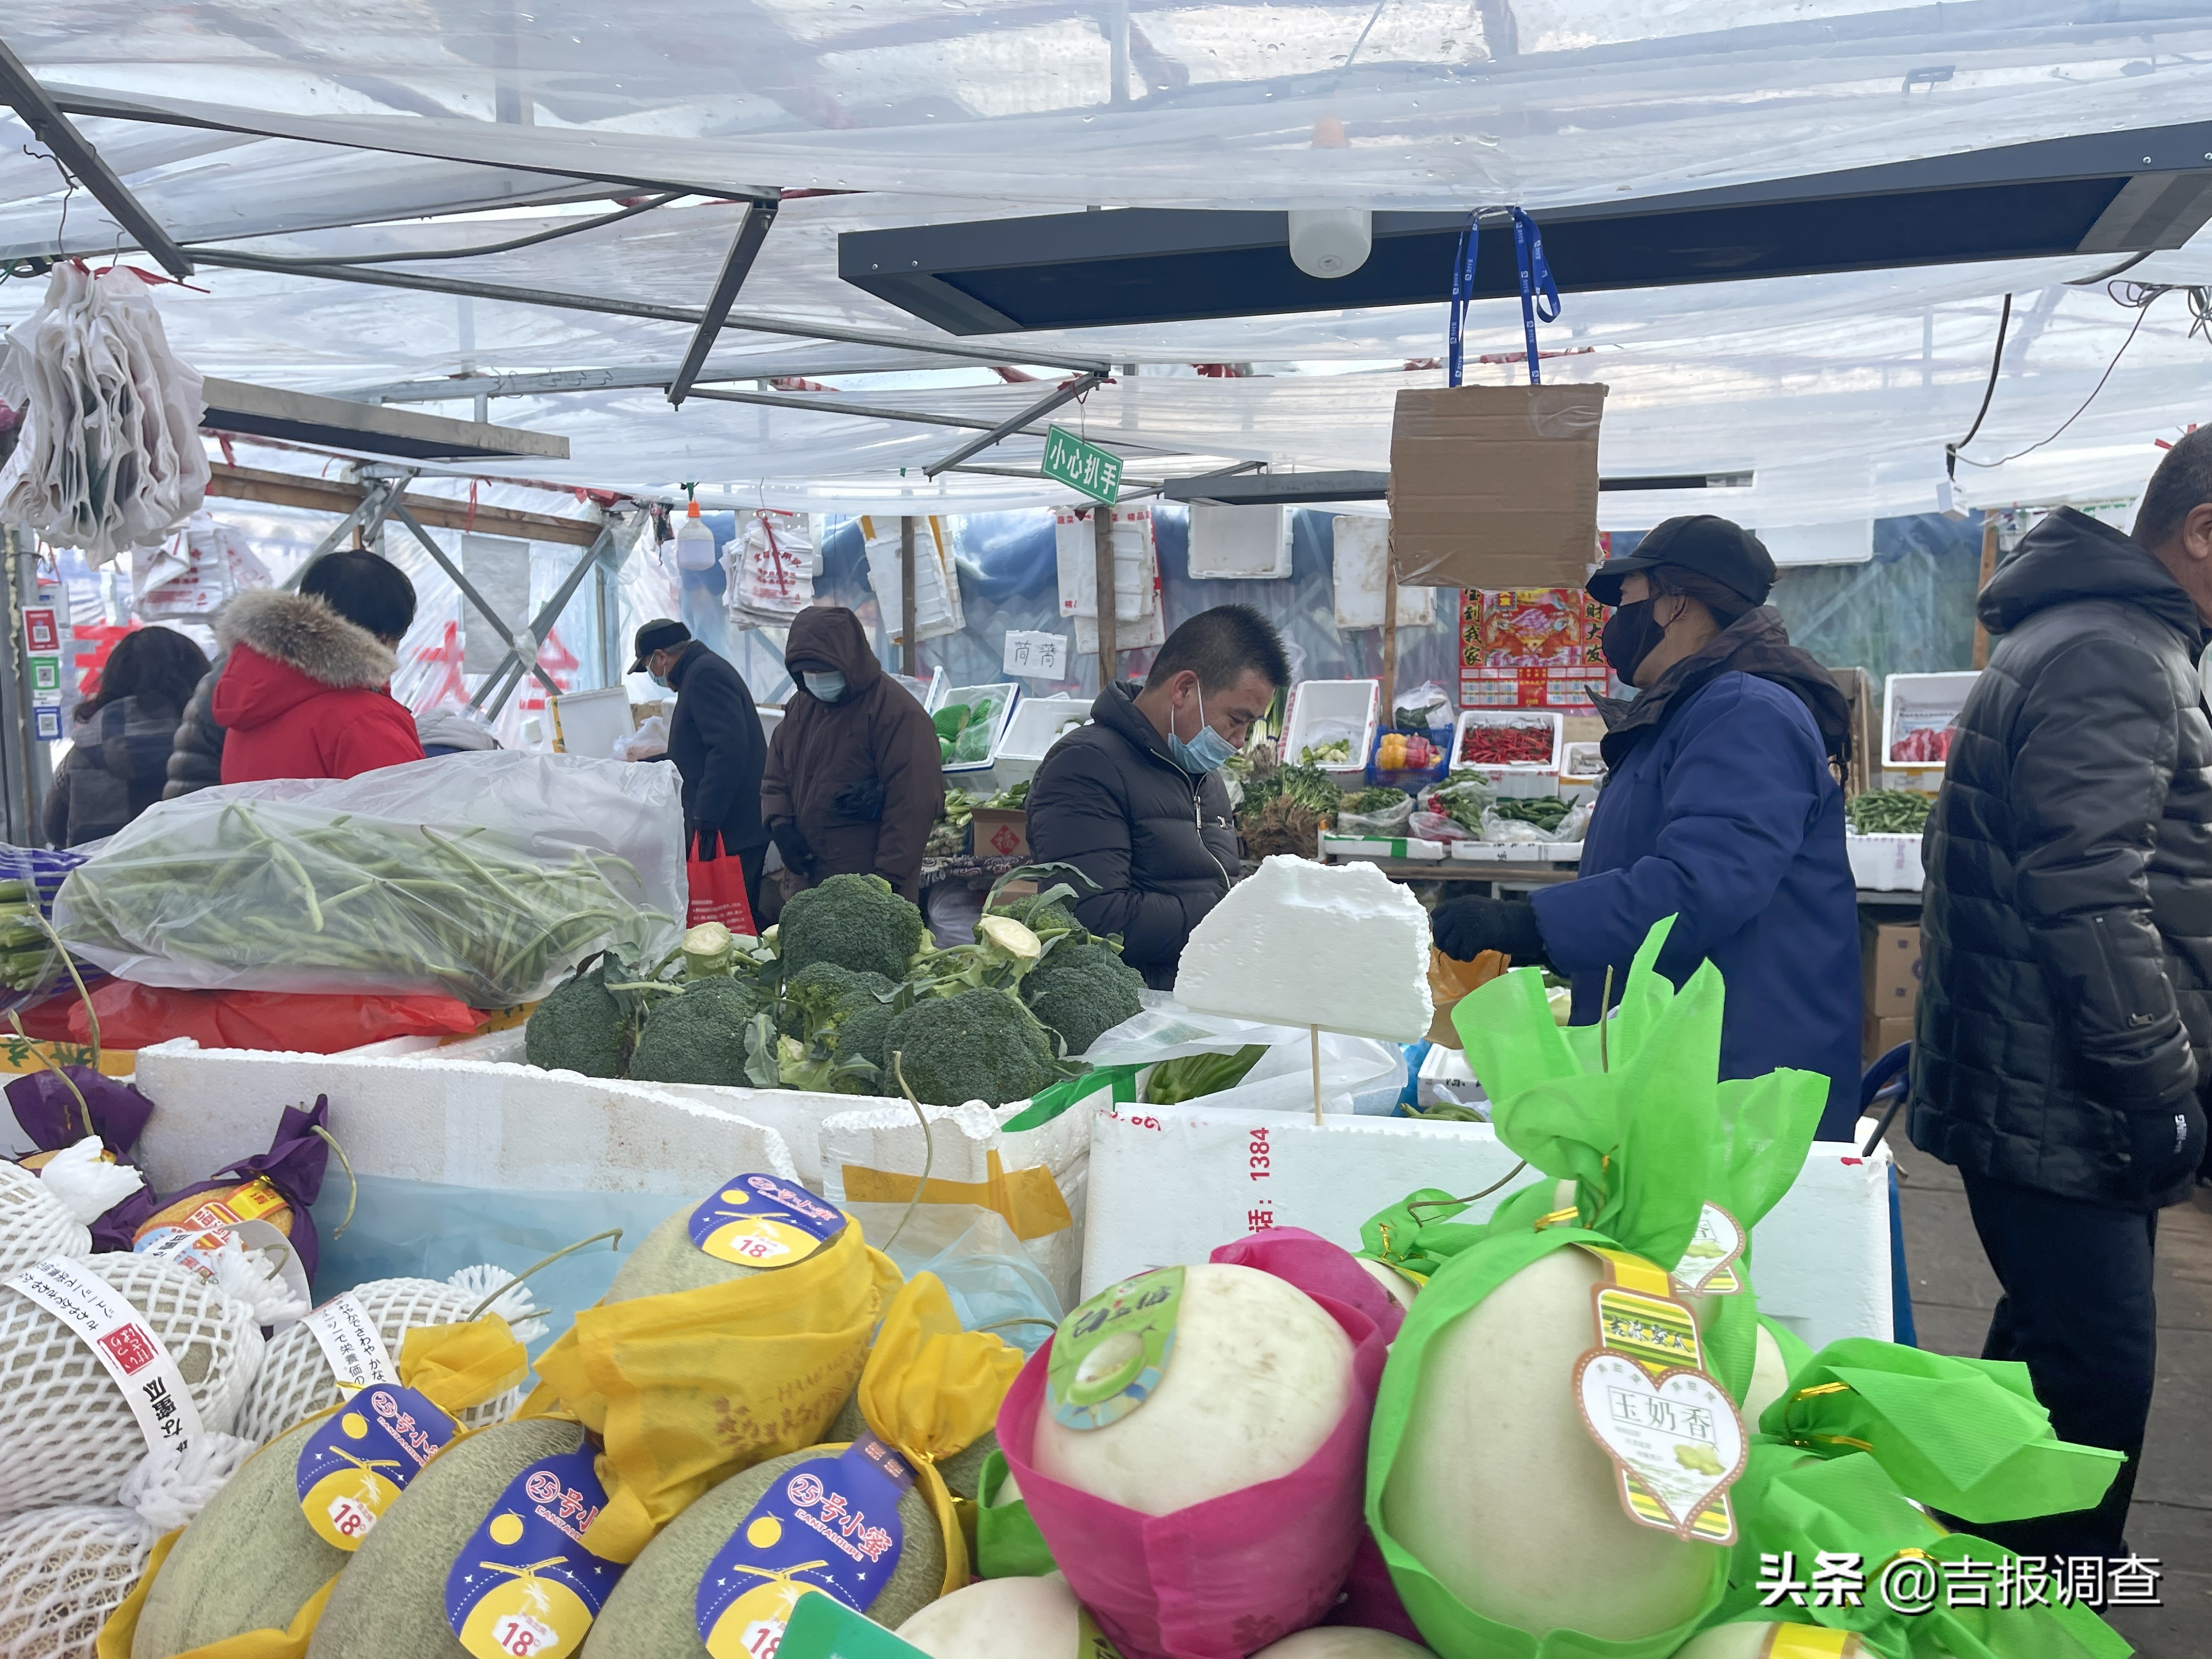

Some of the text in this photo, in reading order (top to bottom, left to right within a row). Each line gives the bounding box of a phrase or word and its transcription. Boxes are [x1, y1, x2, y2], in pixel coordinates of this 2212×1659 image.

[1049, 438, 1117, 495] 小心扒手
[1014, 640, 1056, 668] 茼蒿
[794, 1508, 865, 1562] CANTALOUPE
